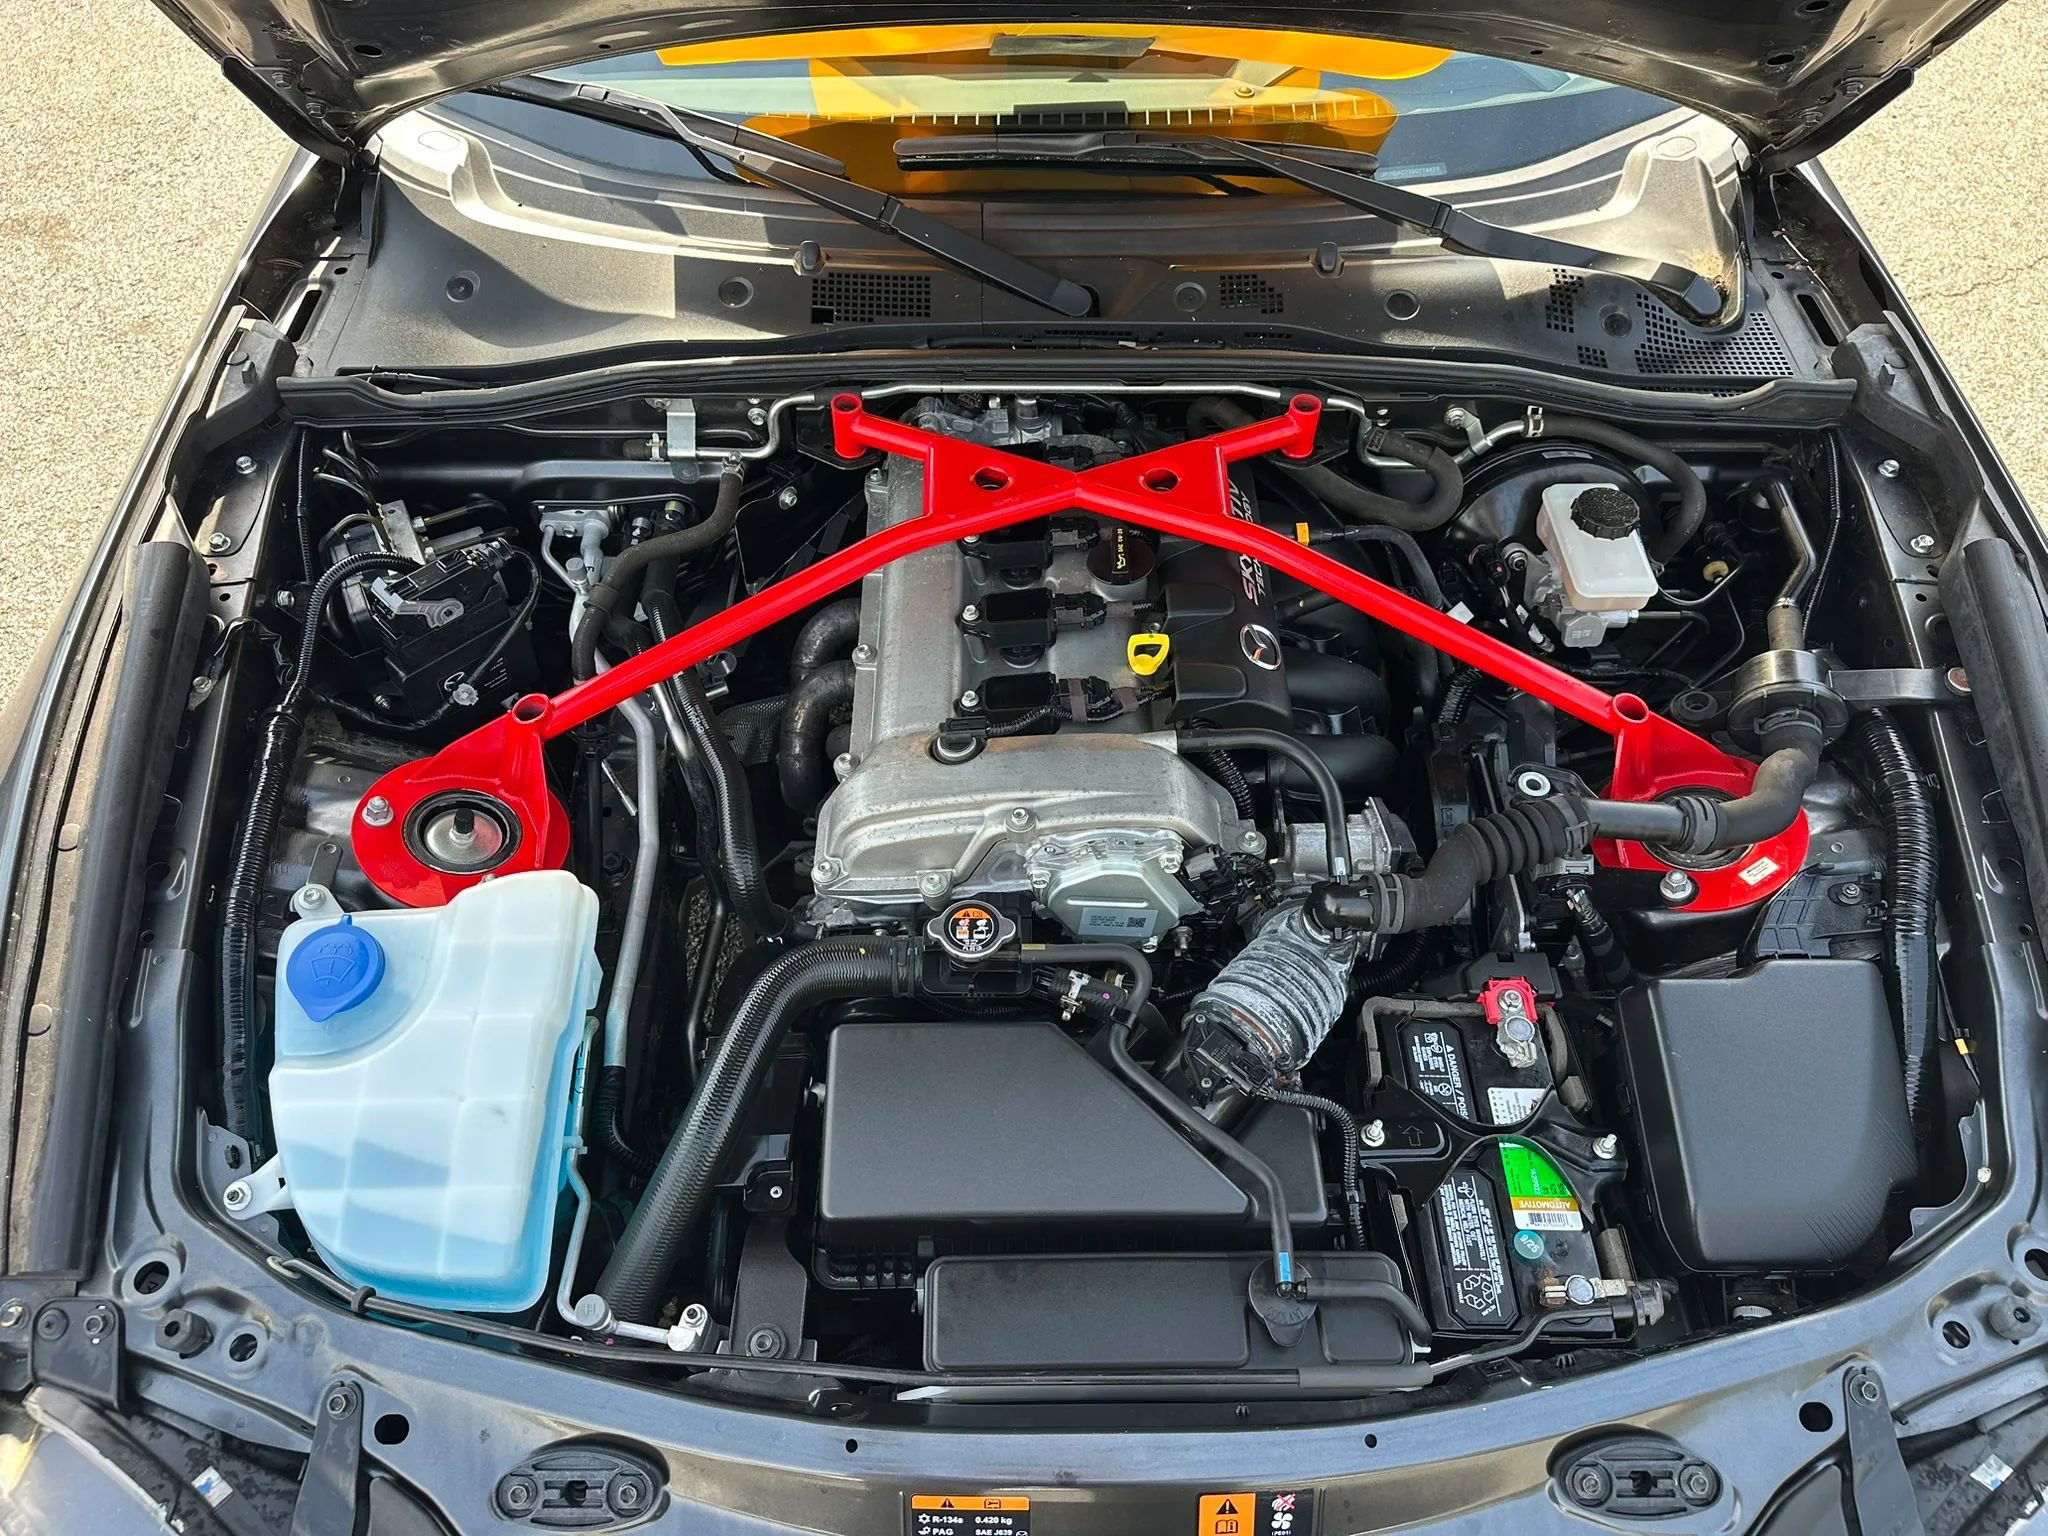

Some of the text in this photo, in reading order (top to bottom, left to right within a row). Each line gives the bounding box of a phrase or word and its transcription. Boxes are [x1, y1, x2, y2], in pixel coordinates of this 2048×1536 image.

[1228, 479, 1258, 606] SKYTIV
[1448, 1053, 1461, 1089] DANGER
[1518, 1200, 1571, 1208] AUTOMOTIVE
[1519, 1234, 1538, 1252] 9/25
[932, 1515, 1013, 1526] R-134a 0.420 kg
[932, 1528, 954, 1536] PAG
